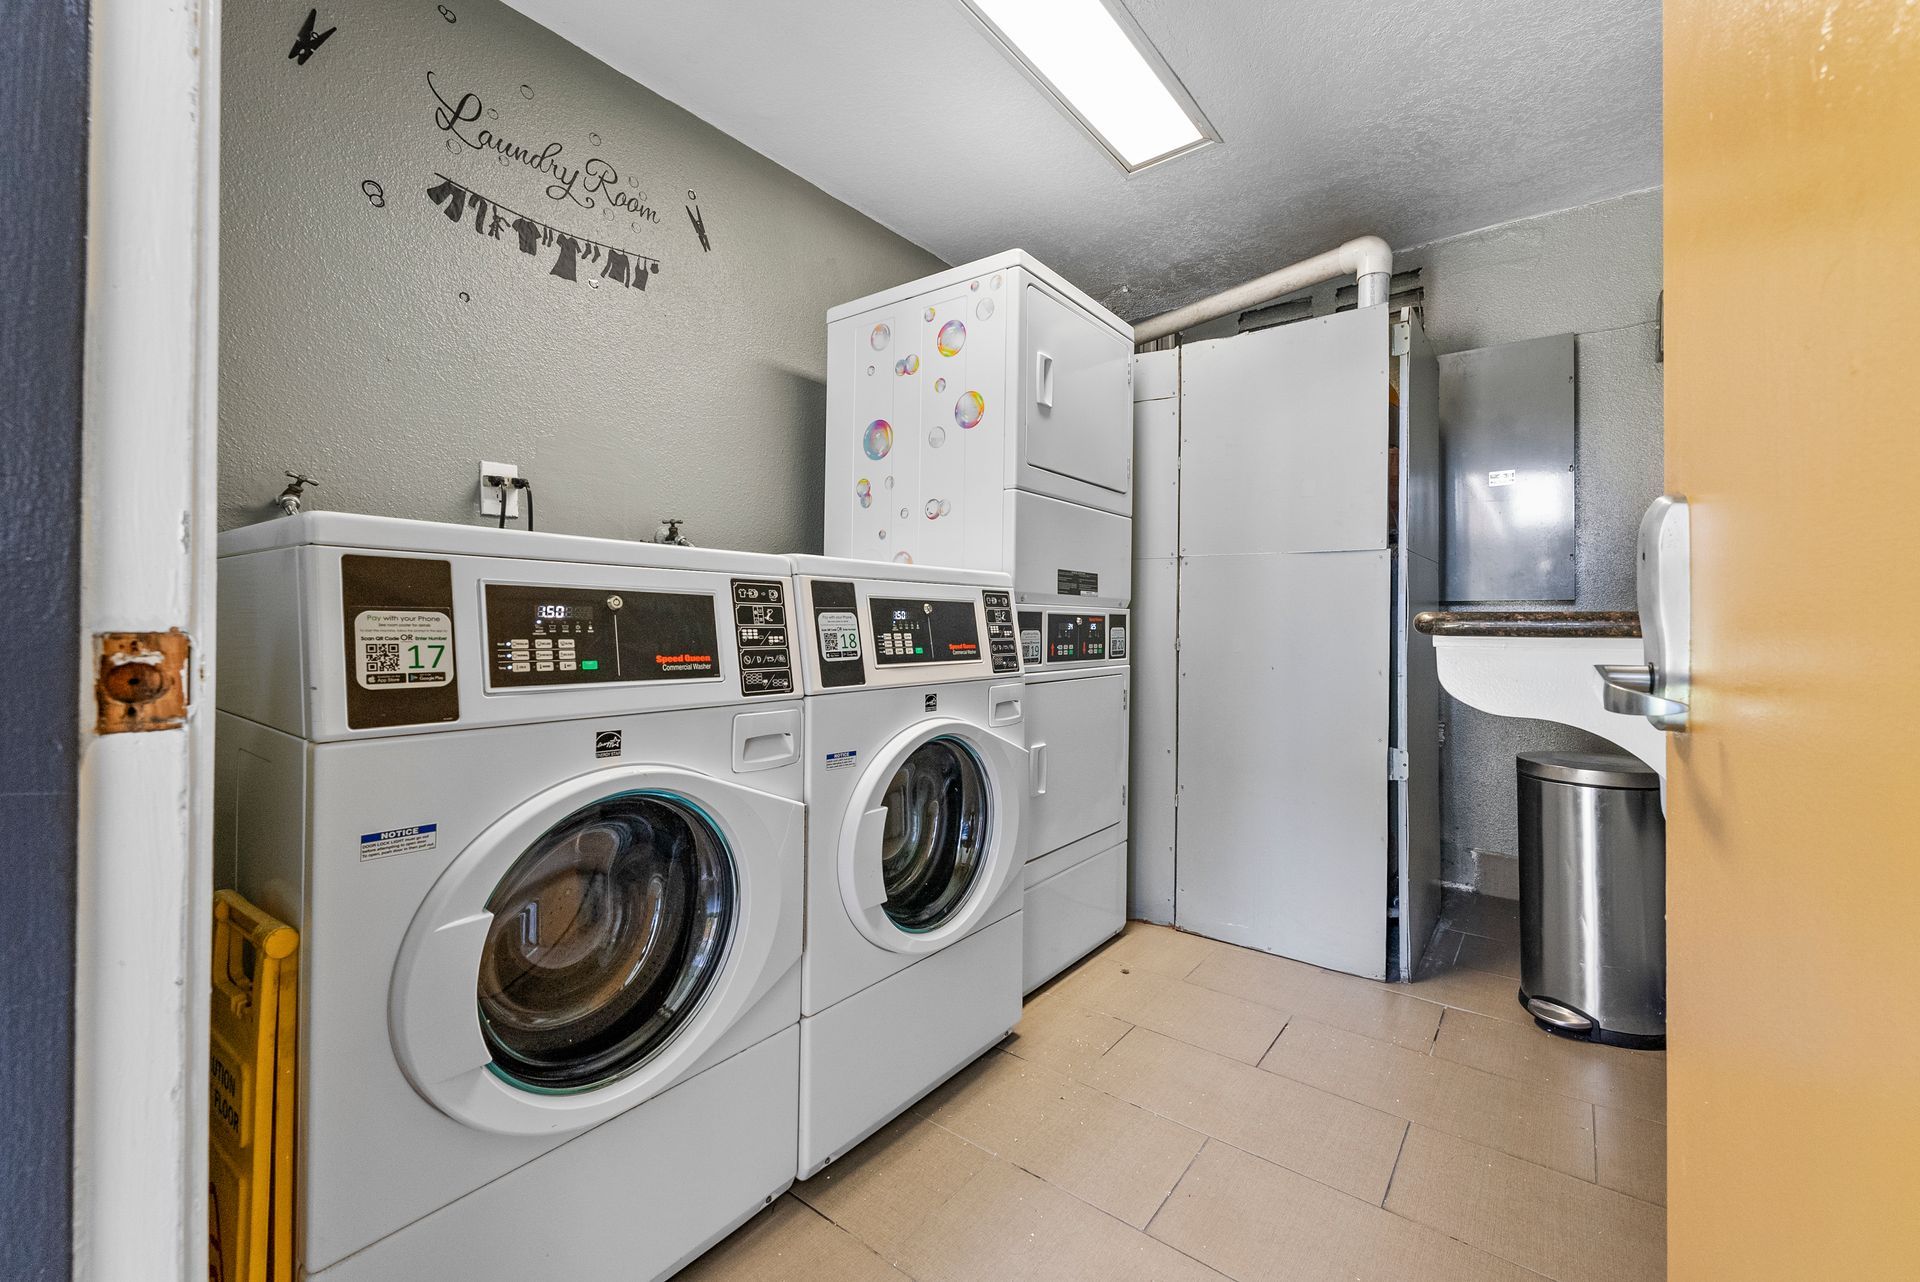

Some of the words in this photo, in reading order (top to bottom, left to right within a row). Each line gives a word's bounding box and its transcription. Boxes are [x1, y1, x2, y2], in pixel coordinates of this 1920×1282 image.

[427, 71, 594, 209] Laundry
[583, 159, 661, 224] Room
[841, 633, 857, 649] 18
[1117, 640, 1124, 650] 20
[408, 645, 445, 669] 17
[1030, 645, 1039, 657] 19
[656, 654, 684, 664] Speed
[684, 654, 711, 662] Queen
[662, 663, 693, 671] Commercial
[381, 827, 419, 840] NOTICE
[211, 1055, 236, 1097] UTION
[214, 1088, 239, 1134] FLOOR
